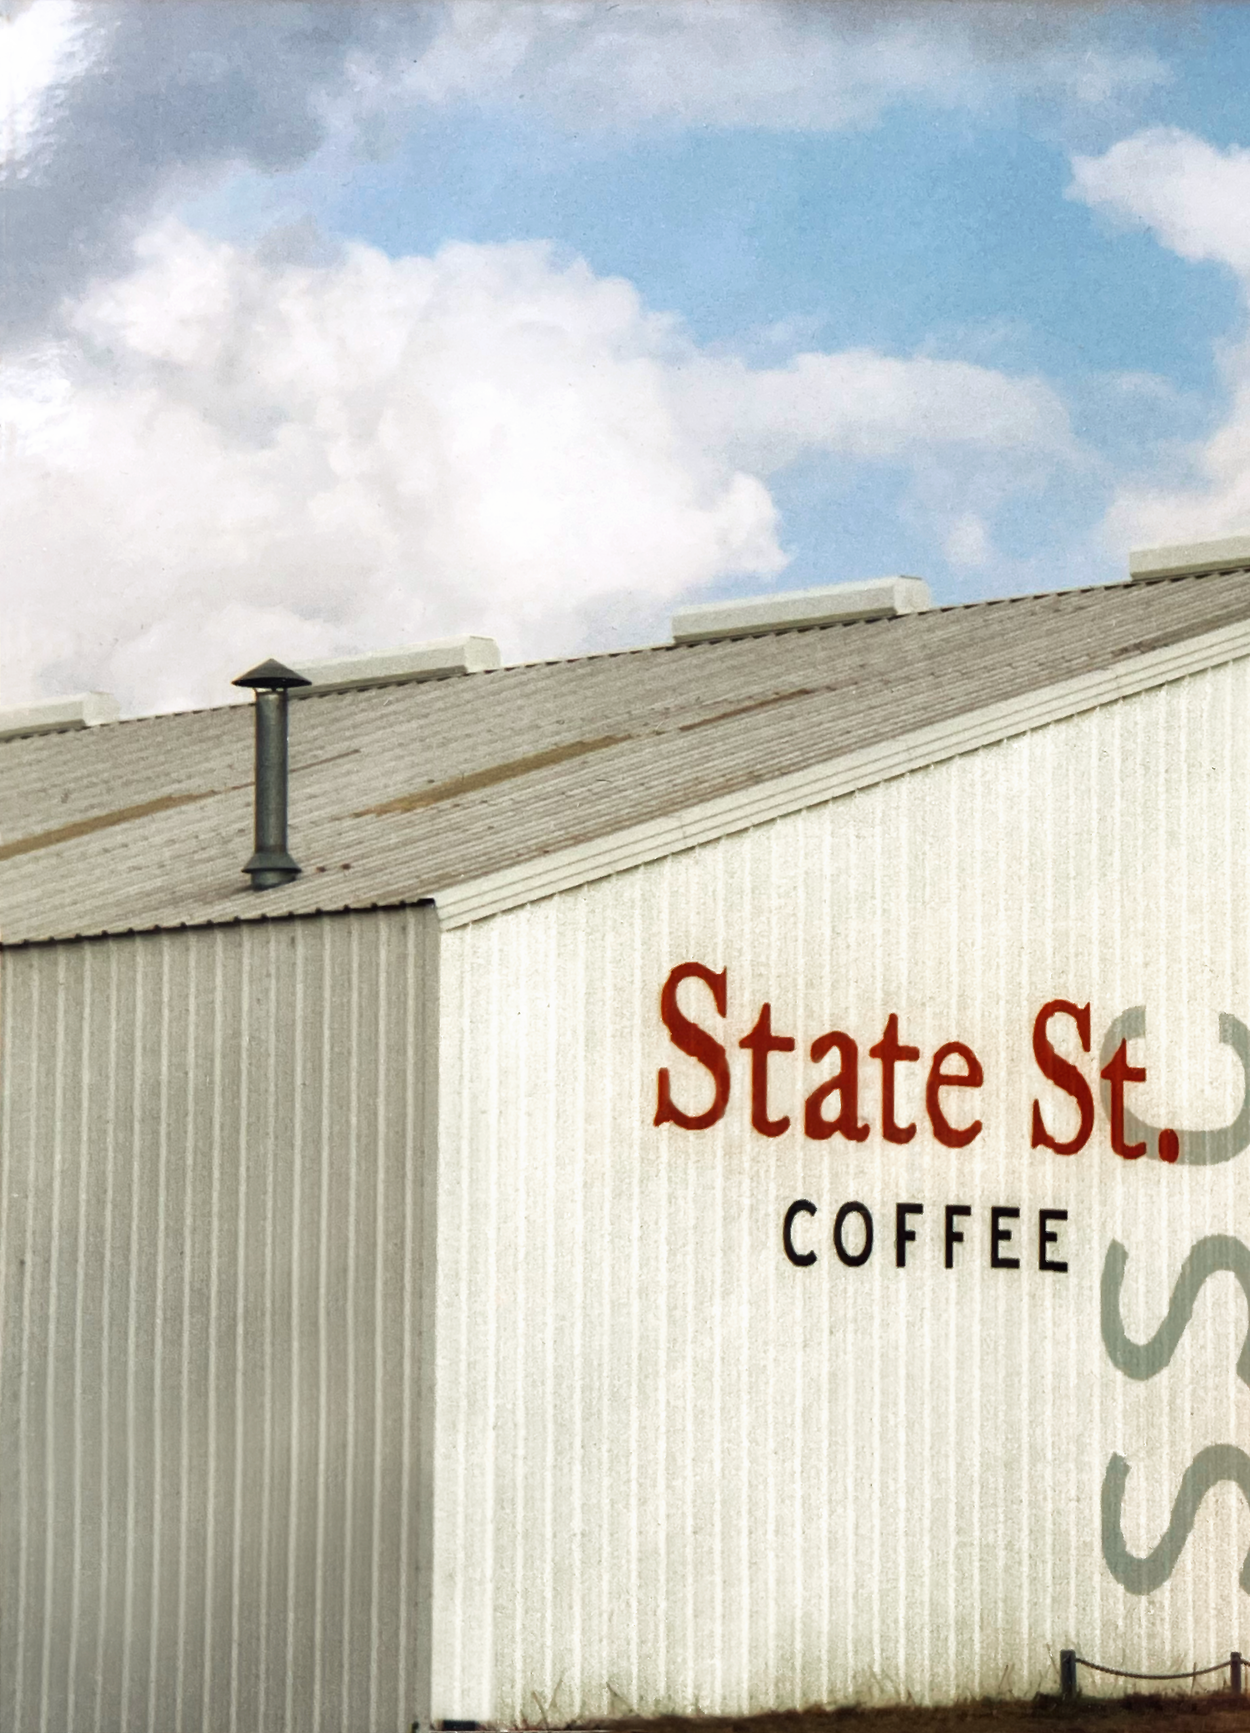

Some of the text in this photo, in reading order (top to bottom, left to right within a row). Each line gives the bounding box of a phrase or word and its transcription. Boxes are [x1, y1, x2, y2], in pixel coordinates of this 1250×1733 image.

[653, 961, 1180, 1163] State St.
[783, 1199, 1069, 1272] COFFEE
